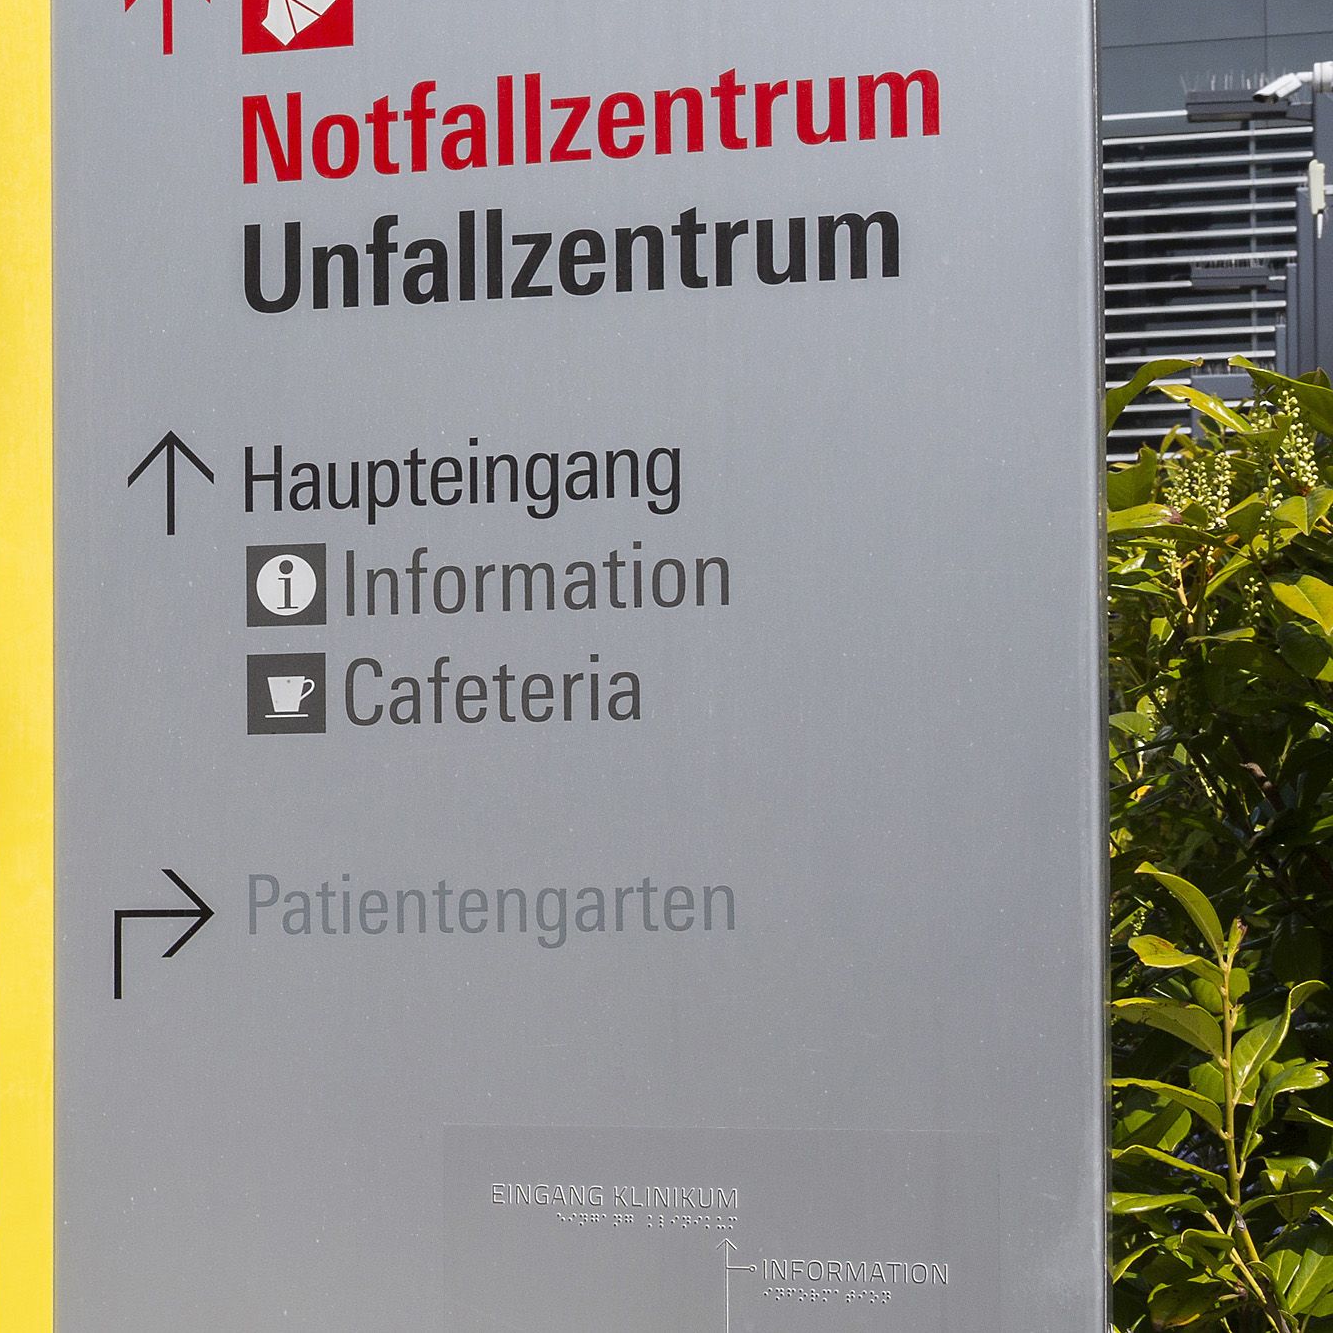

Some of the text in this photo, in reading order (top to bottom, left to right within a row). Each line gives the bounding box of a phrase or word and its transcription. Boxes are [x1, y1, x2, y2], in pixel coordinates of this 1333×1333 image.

[242, 68, 941, 186] Notfallzentrum
[244, 206, 901, 315] Unfallzentrum
[243, 437, 682, 526] Haupteingang
[344, 540, 731, 617] Information
[344, 653, 642, 728] Cafeteria
[247, 872, 736, 950] Patientengarten
[490, 1182, 739, 1210] EINGANG KLINIKUM
[761, 1258, 949, 1286] INFORMATION
